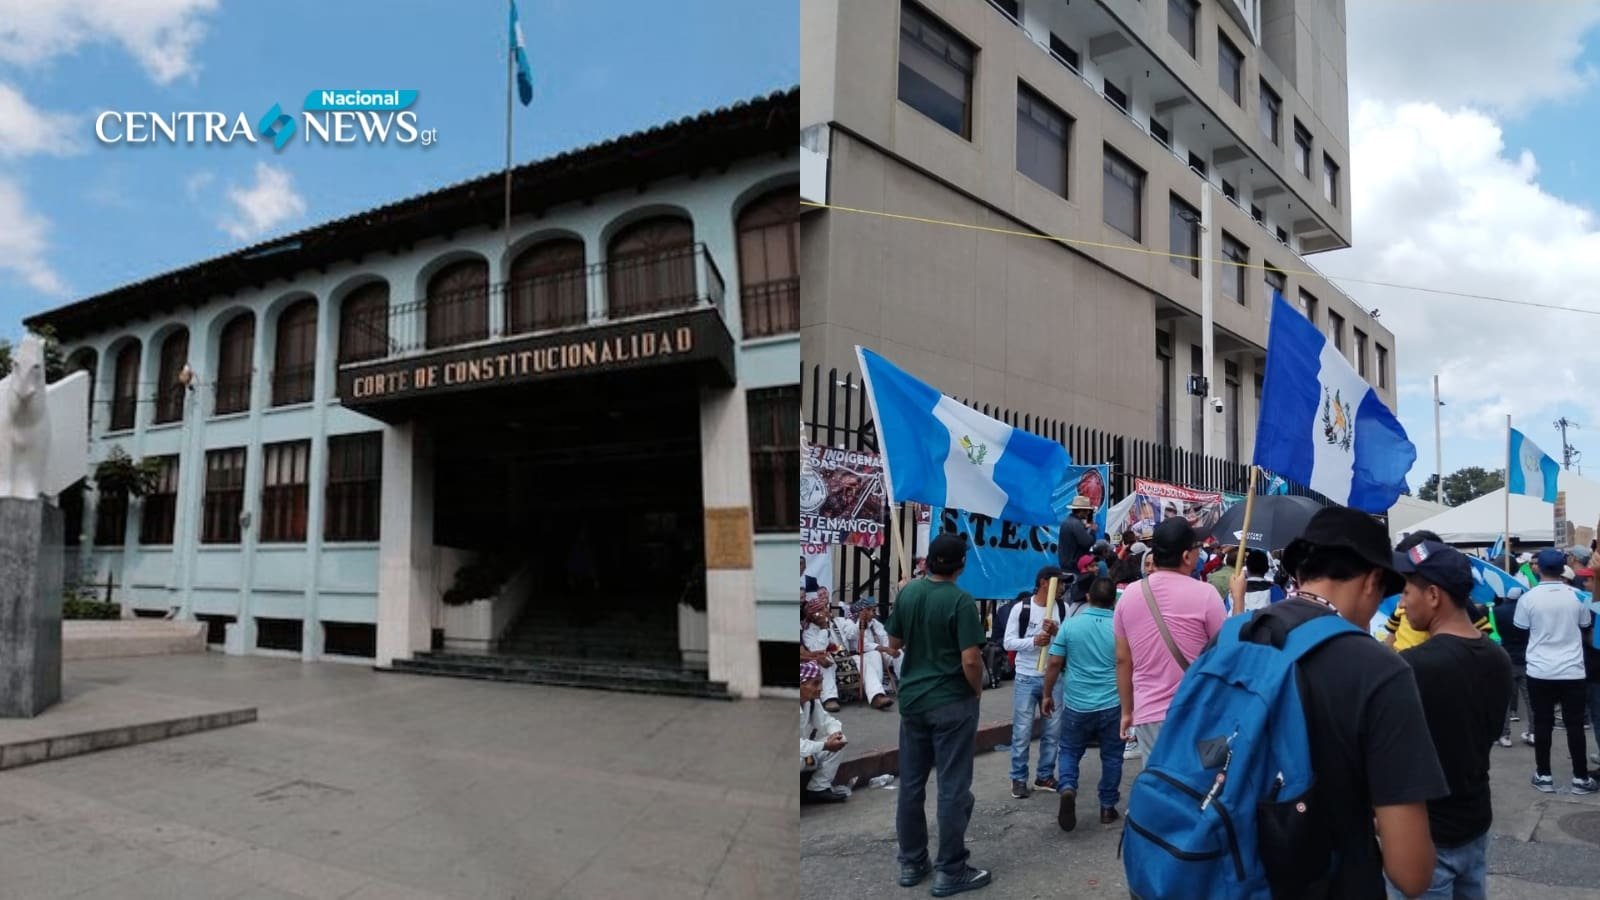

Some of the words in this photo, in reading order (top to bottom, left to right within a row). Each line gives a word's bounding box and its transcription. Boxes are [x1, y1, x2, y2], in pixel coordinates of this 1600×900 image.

[353, 370, 409, 398] CORTE
[414, 364, 438, 389] DE
[444, 326, 692, 385] CONSTITUCIONALIDAD
